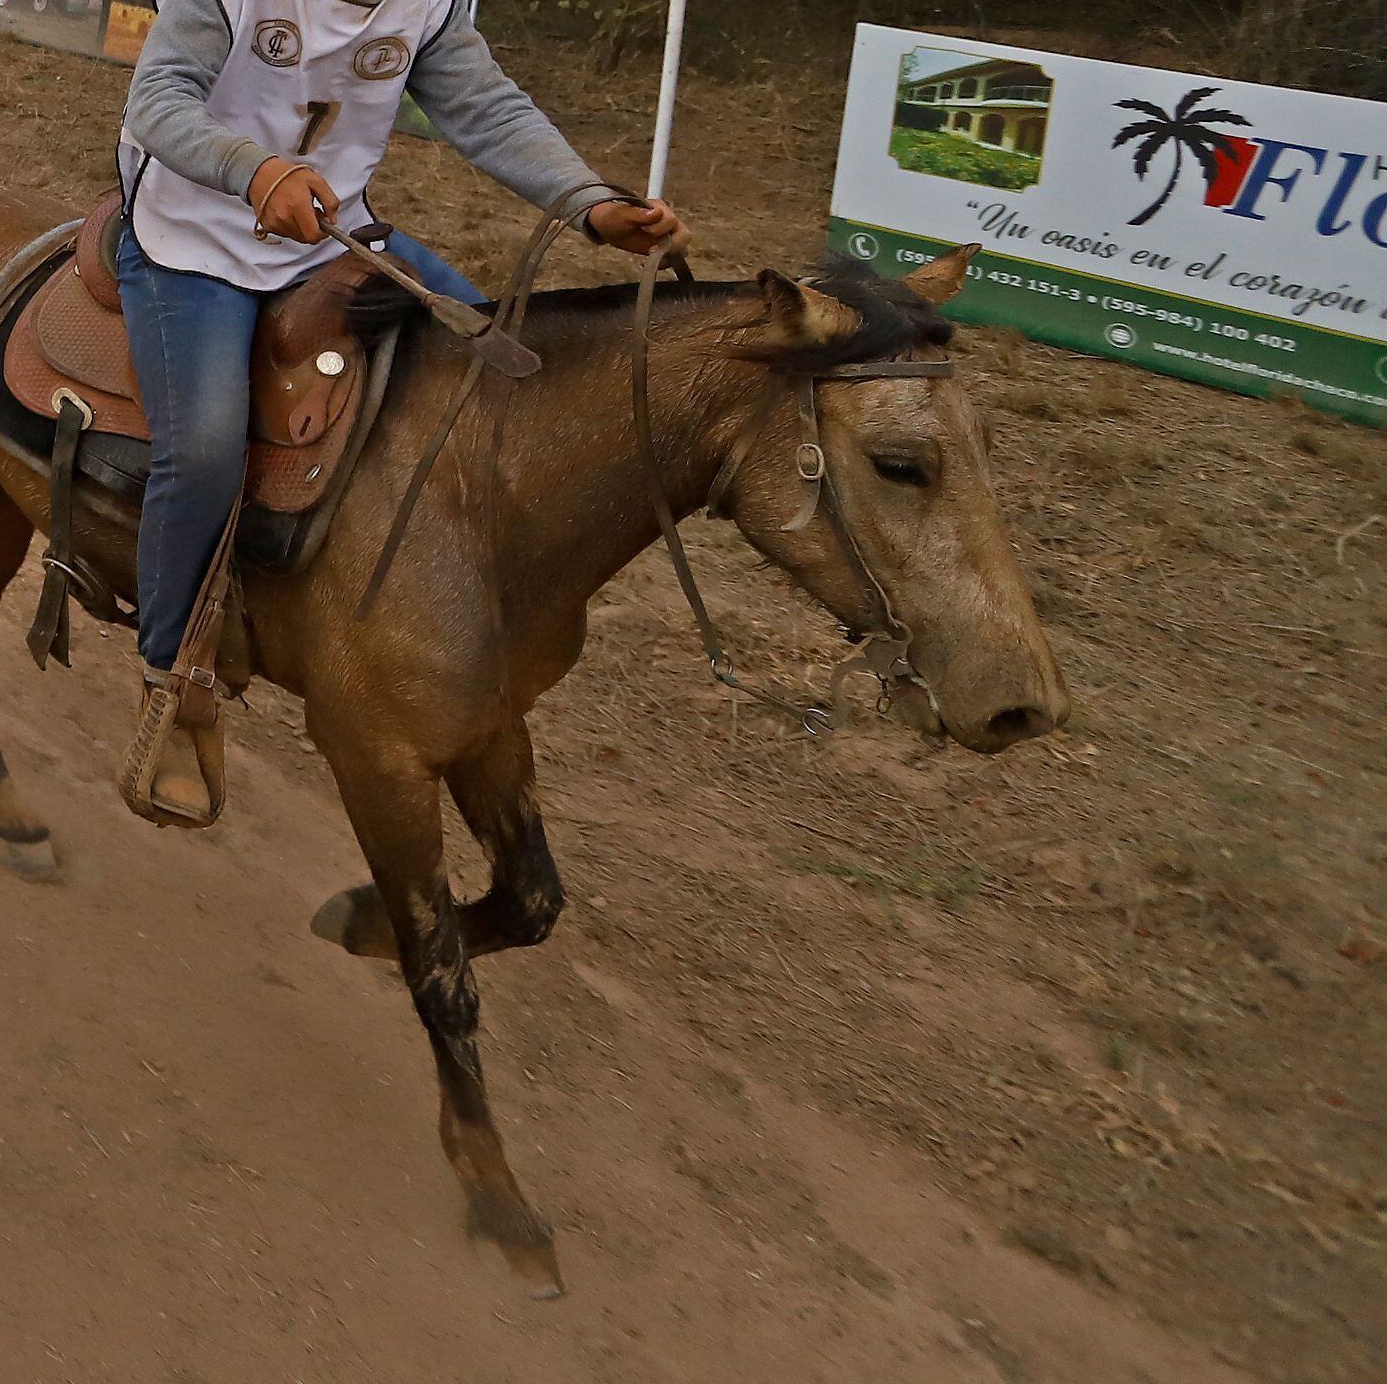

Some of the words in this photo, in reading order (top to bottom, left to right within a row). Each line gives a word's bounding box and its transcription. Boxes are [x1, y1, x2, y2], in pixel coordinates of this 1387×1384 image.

[296, 101, 332, 156] 7
[986, 271, 1023, 288] 432
[1027, 279, 1082, 301] 151-3
[1253, 332, 1297, 353] 402
[1041, 231, 1120, 260] oasis
[1130, 248, 1172, 271] en
[1184, 253, 1227, 280] el
[1229, 271, 1368, 316] corazón
